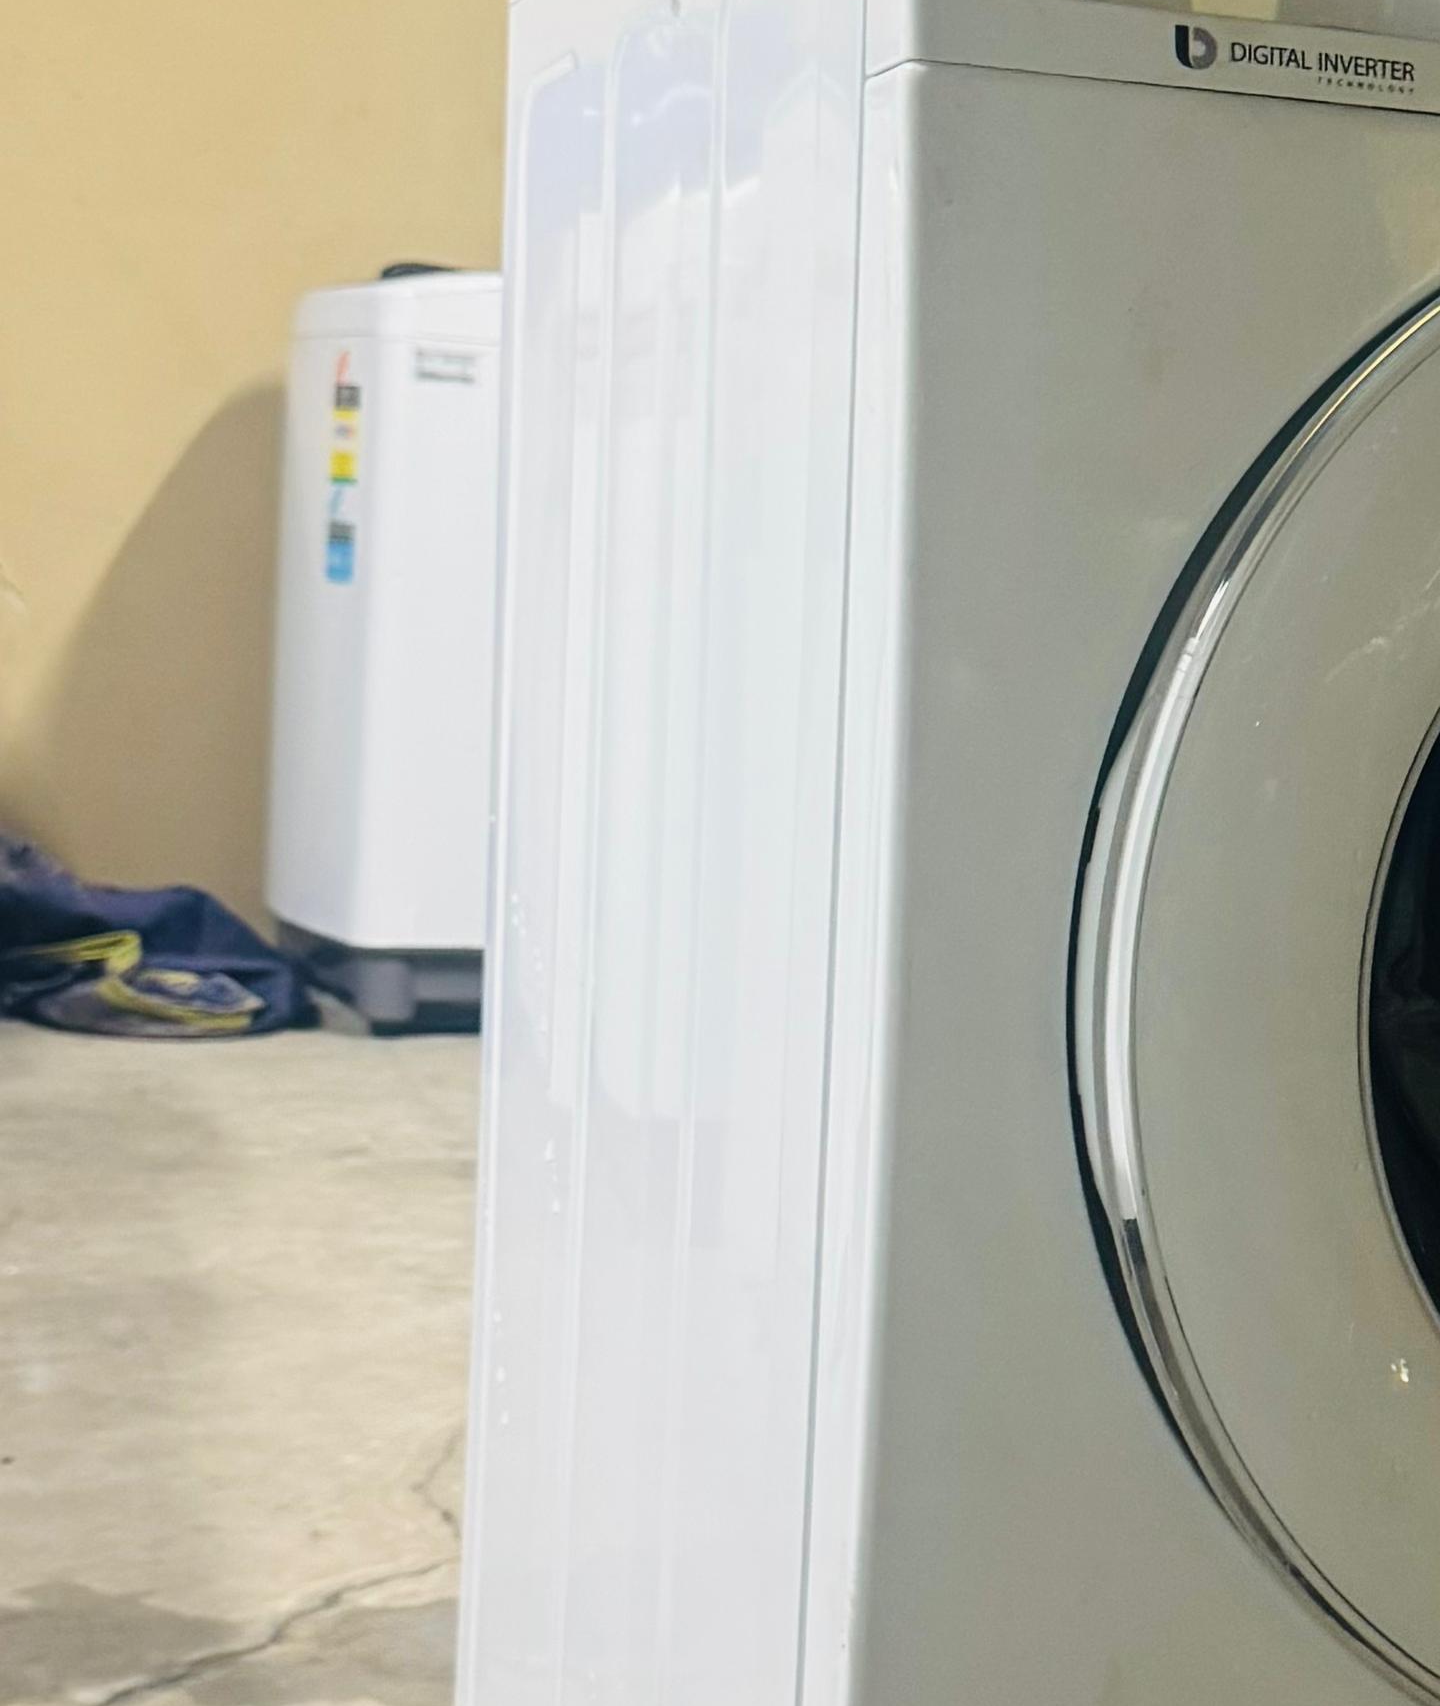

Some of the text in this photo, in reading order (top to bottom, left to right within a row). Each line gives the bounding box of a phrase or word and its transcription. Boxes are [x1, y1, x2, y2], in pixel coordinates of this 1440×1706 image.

[1231, 42, 1415, 82] DIGITAL INVERTER
[1318, 76, 1415, 94] TECHNOLOGY
